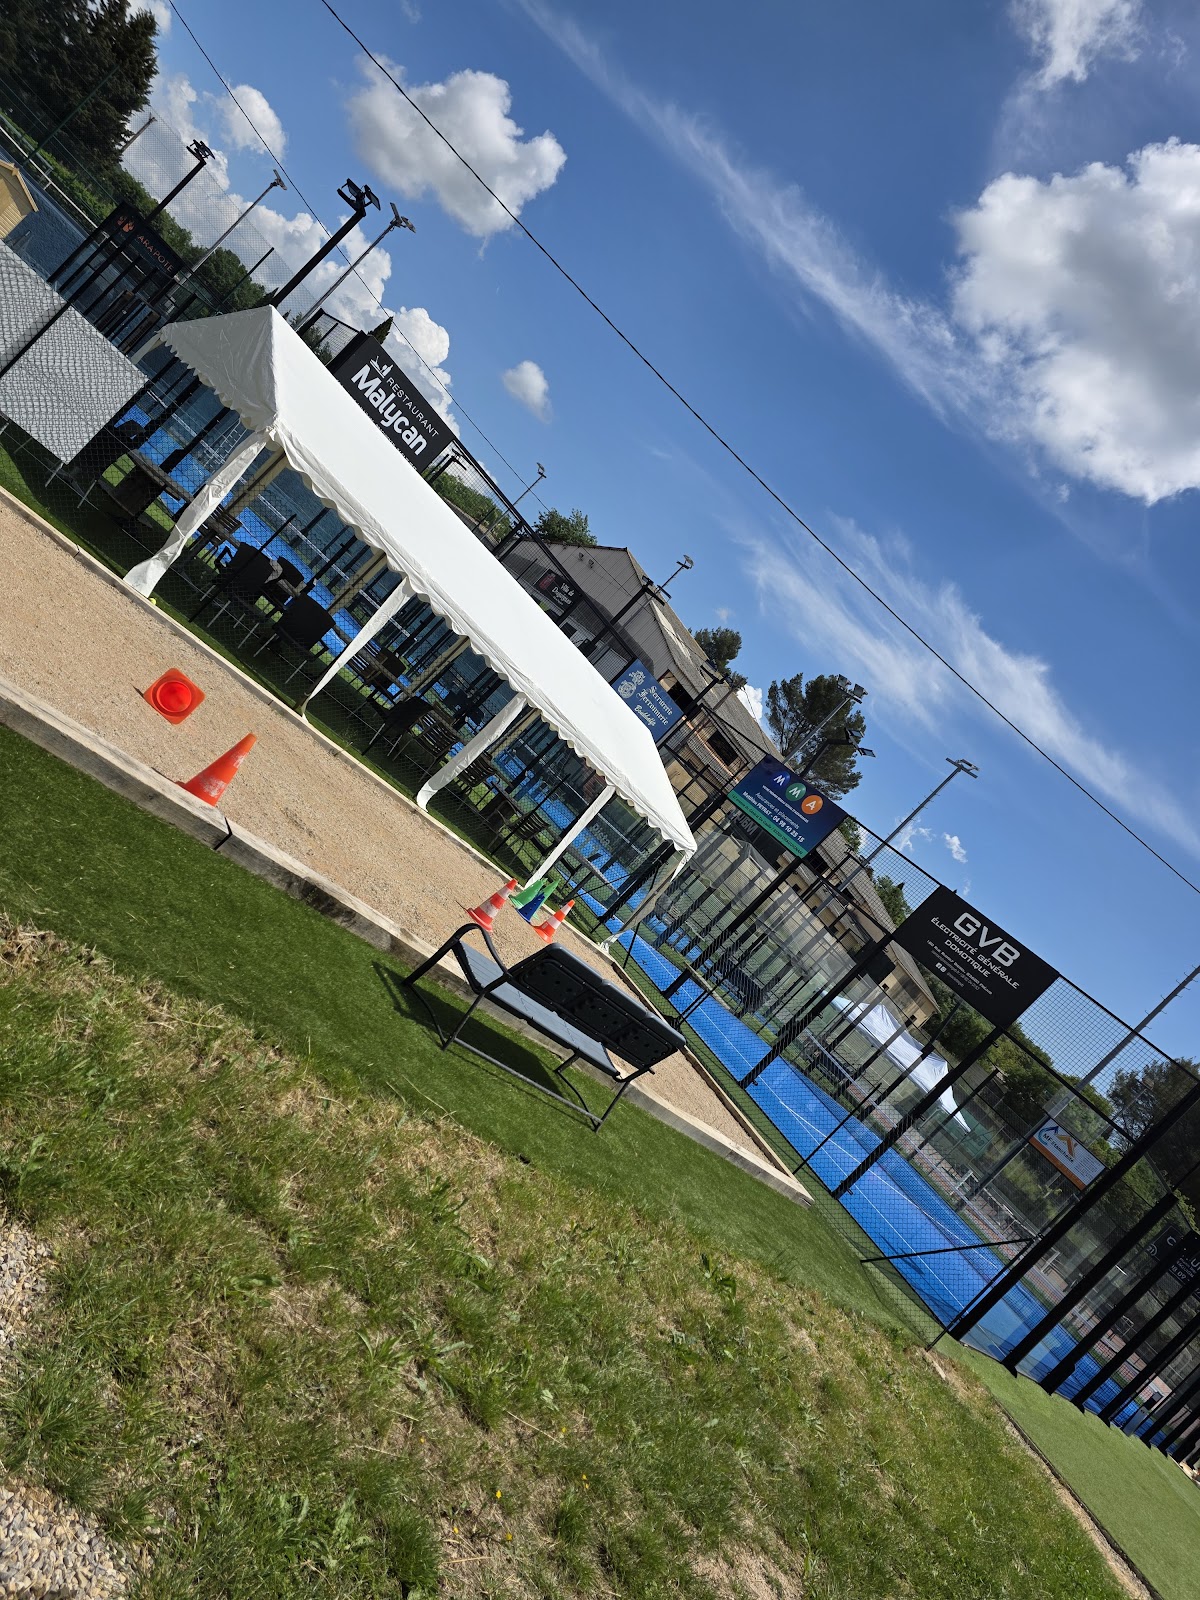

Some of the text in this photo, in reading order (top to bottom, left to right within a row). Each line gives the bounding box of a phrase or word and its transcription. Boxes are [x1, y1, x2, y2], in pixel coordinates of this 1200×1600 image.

[350, 363, 427, 455] Malycan
[386, 376, 438, 438] RESTAURANT
[649, 685, 672, 715] Serrurerie
[772, 815, 779, 823] 04
[784, 825, 791, 833] 10
[930, 916, 1020, 989] ÉLECTRICITÉ GÉNÉRALE
[944, 939, 990, 977] DOMOTIQUE
[952, 912, 1021, 967] GVB
